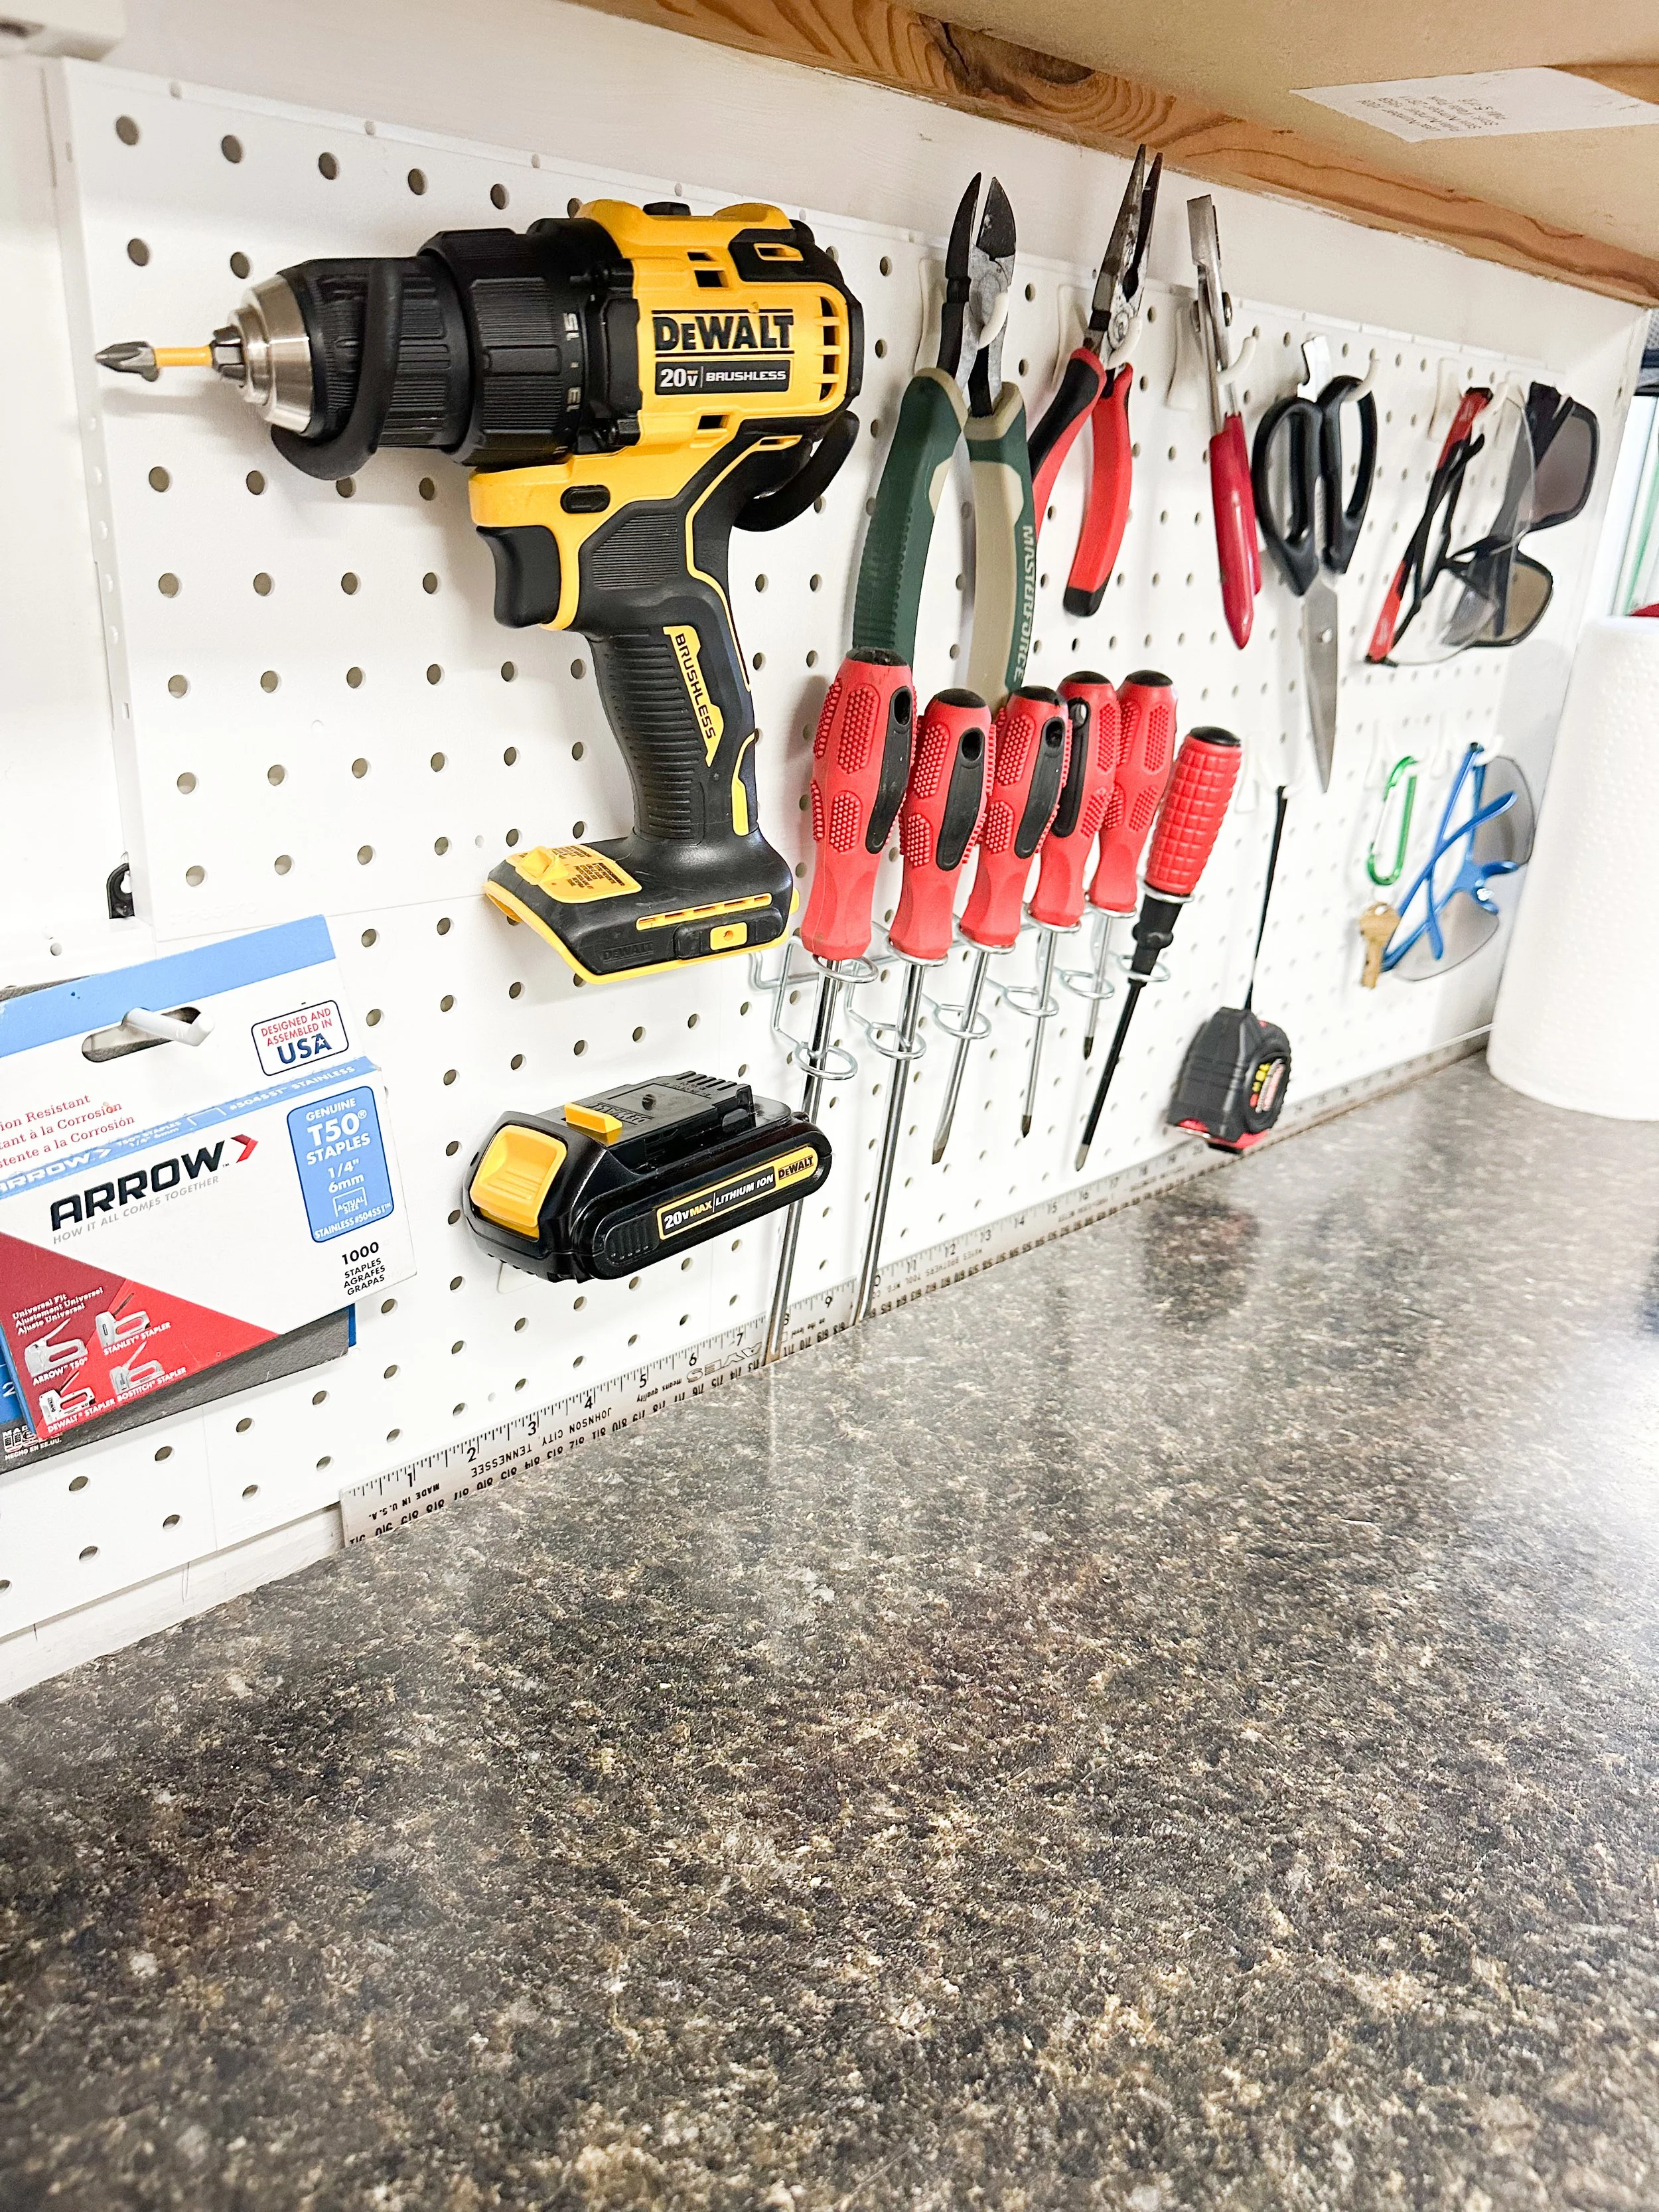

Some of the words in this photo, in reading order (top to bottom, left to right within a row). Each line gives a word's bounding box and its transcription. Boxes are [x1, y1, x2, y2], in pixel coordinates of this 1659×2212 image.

[706, 370, 786, 382] BRUSHLESS
[1014, 526, 1035, 683] MASTERFORCE
[675, 633, 716, 739] BRUSHLESS
[261, 1015, 307, 1037] DESIGNED
[311, 1007, 331, 1021] AND
[267, 1023, 319, 1047] ASSEMBLED
[322, 1019, 332, 1029] IN
[277, 1033, 332, 1064] USA
[291, 1066, 355, 1090] STAINLESS
[25, 1095, 91, 1123] Resistant
[30, 1130, 38, 1139] à
[40, 1126, 54, 1136] la
[57, 1102, 122, 1130] Corrosion
[305, 1098, 356, 1122] GENUINE
[54, 1138, 68, 1149] la
[70, 1116, 135, 1142] Corrosión
[306, 1133, 371, 1165] STAPLES
[328, 1174, 365, 1193] 6mm
[715, 1182, 754, 1206] LITHIUM
[757, 1173, 774, 1189] ION
[53, 1226, 82, 1245] HOW
[87, 1221, 96, 1233] IT
[100, 1213, 119, 1228] ALL
[123, 1197, 161, 1217] COMES
[165, 1175, 220, 1203] TOGETHER
[337, 1196, 365, 1211] ACTUAL
[344, 1204, 359, 1214] SIZE
[314, 1217, 355, 1240] STAINLESS
[342, 1242, 379, 1265] 1000
[343, 1265, 386, 1288] AGRAFES
[344, 1258, 382, 1279] STAPLES
[906, 1275, 920, 1284] TOOL
[347, 1275, 385, 1296] GRAPAS
[13, 1300, 53, 1320] Universal
[54, 1293, 67, 1305] Fit
[15, 1303, 63, 1327] Ajustement
[17, 1320, 44, 1335] Ajuste
[141, 1321, 171, 1339] STAPLER
[407, 1473, 413, 1487] 1
[467, 1447, 476, 1463] 2
[528, 1421, 536, 1436] 3
[585, 1396, 593, 1409] 4
[639, 1374, 647, 1388] 5
[689, 1353, 697, 1366] 6
[737, 1333, 744, 1346] 7
[825, 1295, 833, 1308] 9
[907, 1260, 916, 1273] 11
[944, 1243, 956, 1257] 12
[980, 1229, 991, 1242] 13
[1015, 1215, 1025, 1228] 14
[1047, 1202, 1057, 1214] 15
[157, 1366, 187, 1384] STAPLER
[662, 1377, 682, 1391] means
[636, 1388, 659, 1402] quality
[84, 1398, 116, 1417] STAPLER
[569, 1407, 612, 1434] JOHNSON
[5, 1448, 28, 1460] HECHO
[471, 1443, 532, 1478] TENNESSEE
[402, 1497, 411, 1507] IN
[416, 1483, 441, 1500] MADE
